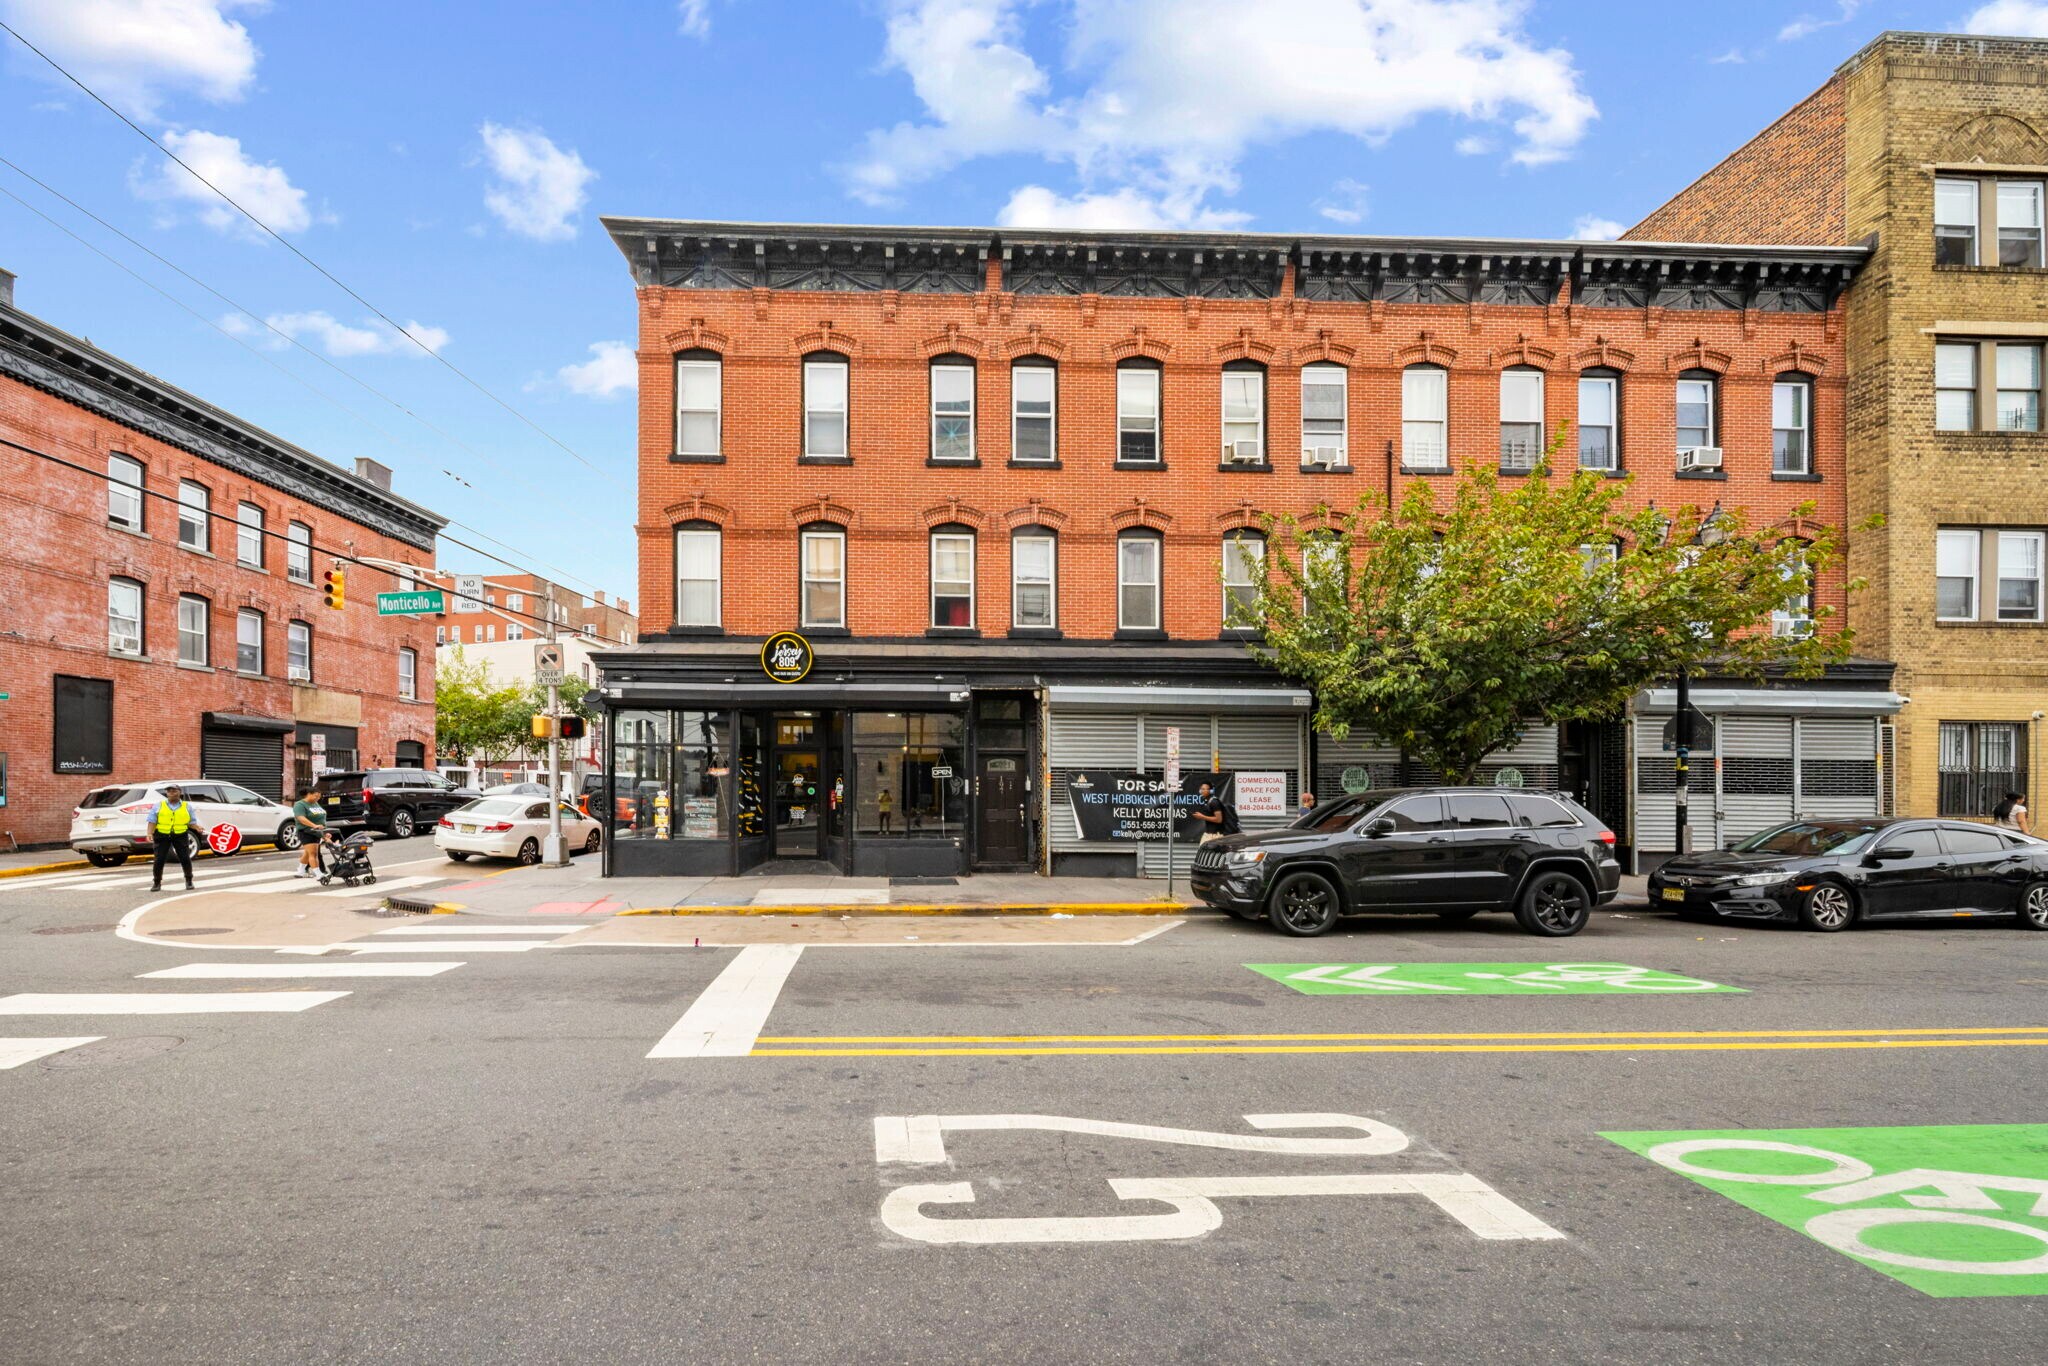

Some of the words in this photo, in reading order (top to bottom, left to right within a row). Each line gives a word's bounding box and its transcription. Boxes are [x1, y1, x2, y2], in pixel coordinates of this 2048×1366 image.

[463, 580, 475, 588] NO
[380, 595, 430, 612] Monticello
[432, 601, 441, 609] Ave
[778, 656, 796, 668] 809
[1117, 779, 1146, 792] FOR
[1148, 780, 1184, 792] SAE
[1082, 793, 1109, 804] WEST
[1111, 793, 1157, 805] HOBOKEN
[1113, 807, 1142, 819] KELLY
[215, 824, 235, 851] STOP
[1120, 830, 1181, 840] kelly@nynjcre.cm
[873, 1112, 1567, 1244] 25
